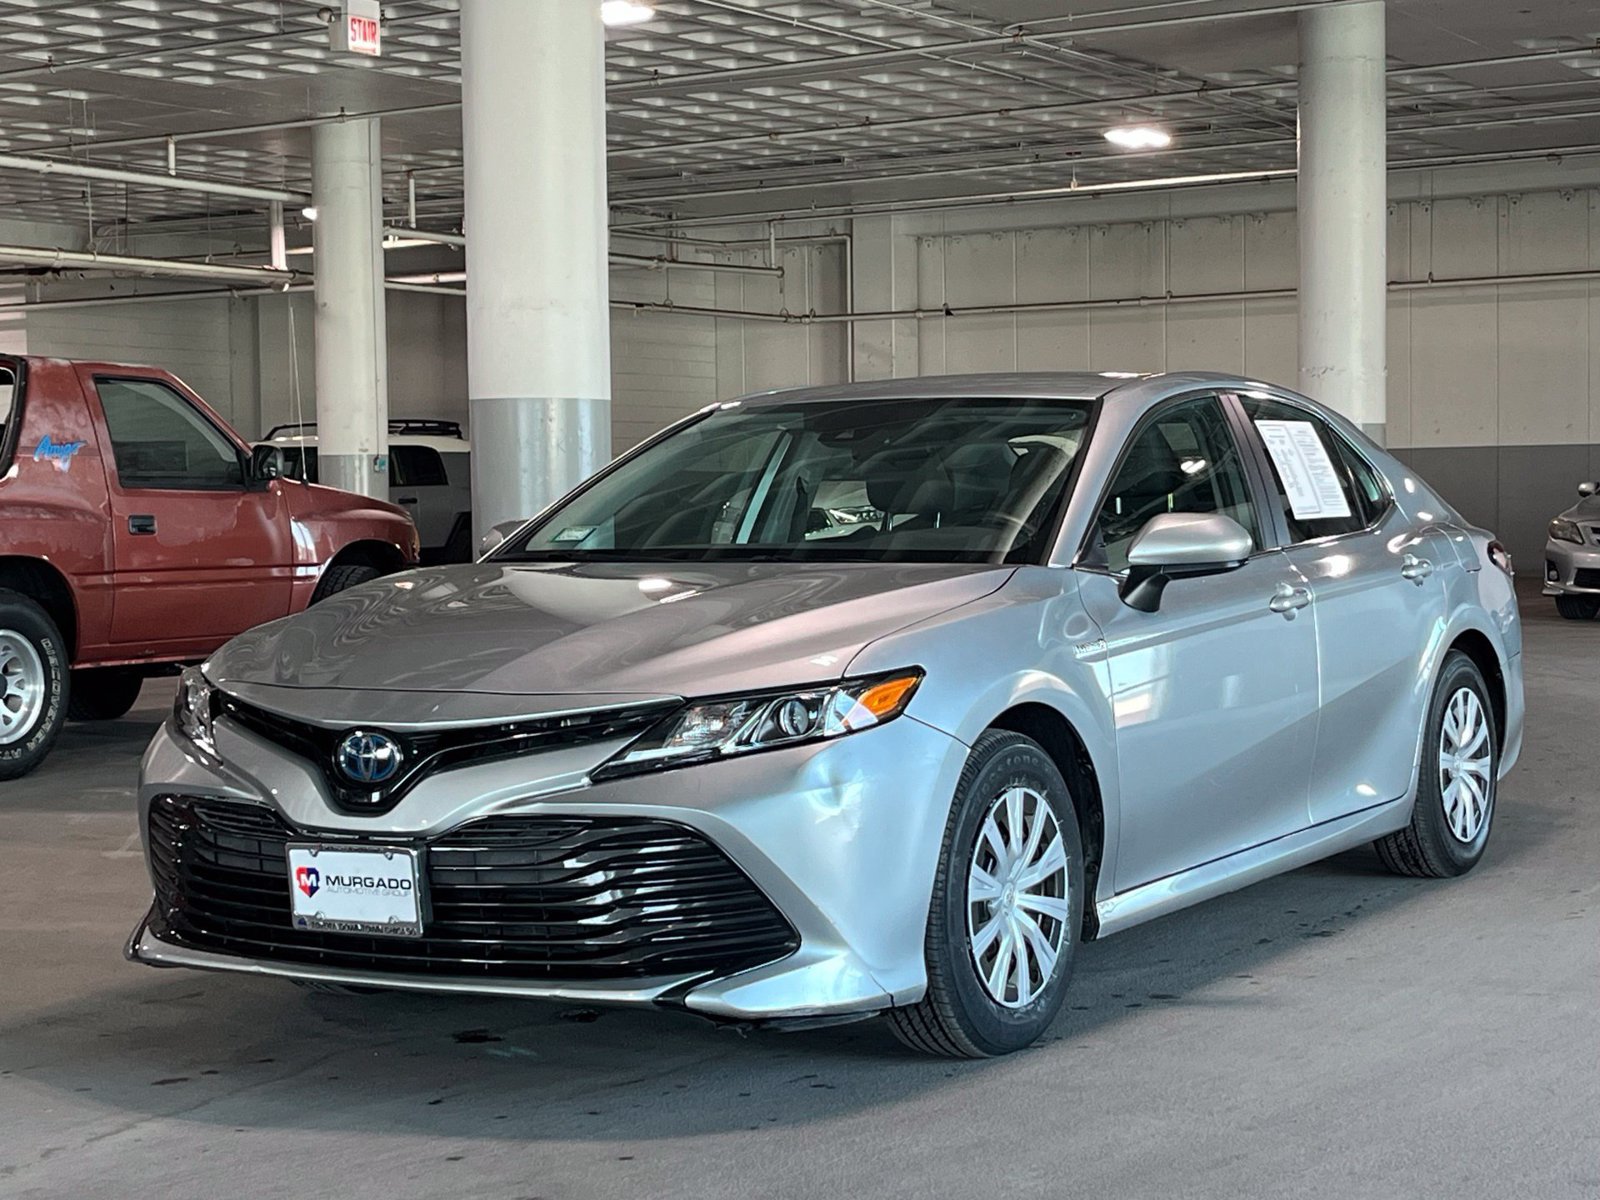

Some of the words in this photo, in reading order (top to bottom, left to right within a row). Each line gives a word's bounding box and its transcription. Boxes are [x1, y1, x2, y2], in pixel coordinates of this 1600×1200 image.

[350, 17, 377, 45] STAIR
[325, 875, 412, 890] MURGADO
[326, 886, 380, 895] AUTOMOTIVE
[382, 889, 411, 897] GROUP
